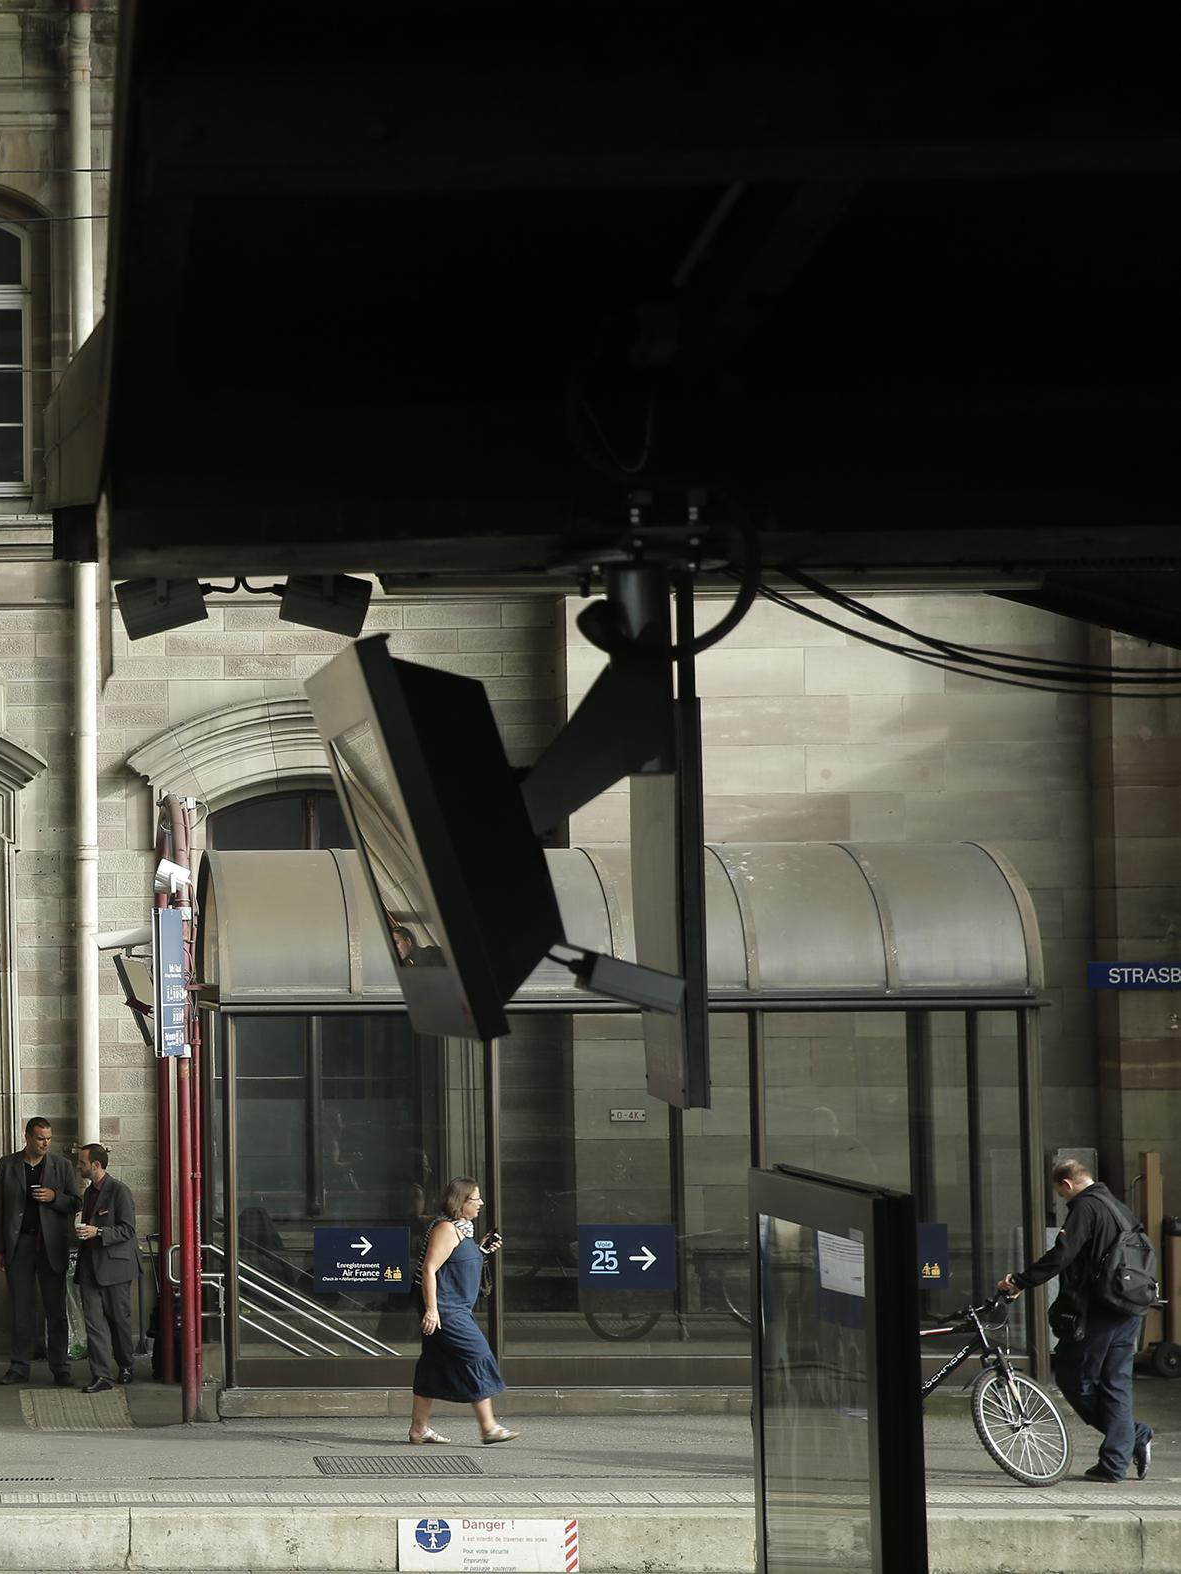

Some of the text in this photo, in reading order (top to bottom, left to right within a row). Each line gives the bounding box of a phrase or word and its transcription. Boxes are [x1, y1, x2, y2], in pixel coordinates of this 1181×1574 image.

[591, 1250, 618, 1270] 25
[342, 1269, 380, 1277] Air France
[462, 1519, 506, 1532] Danger
